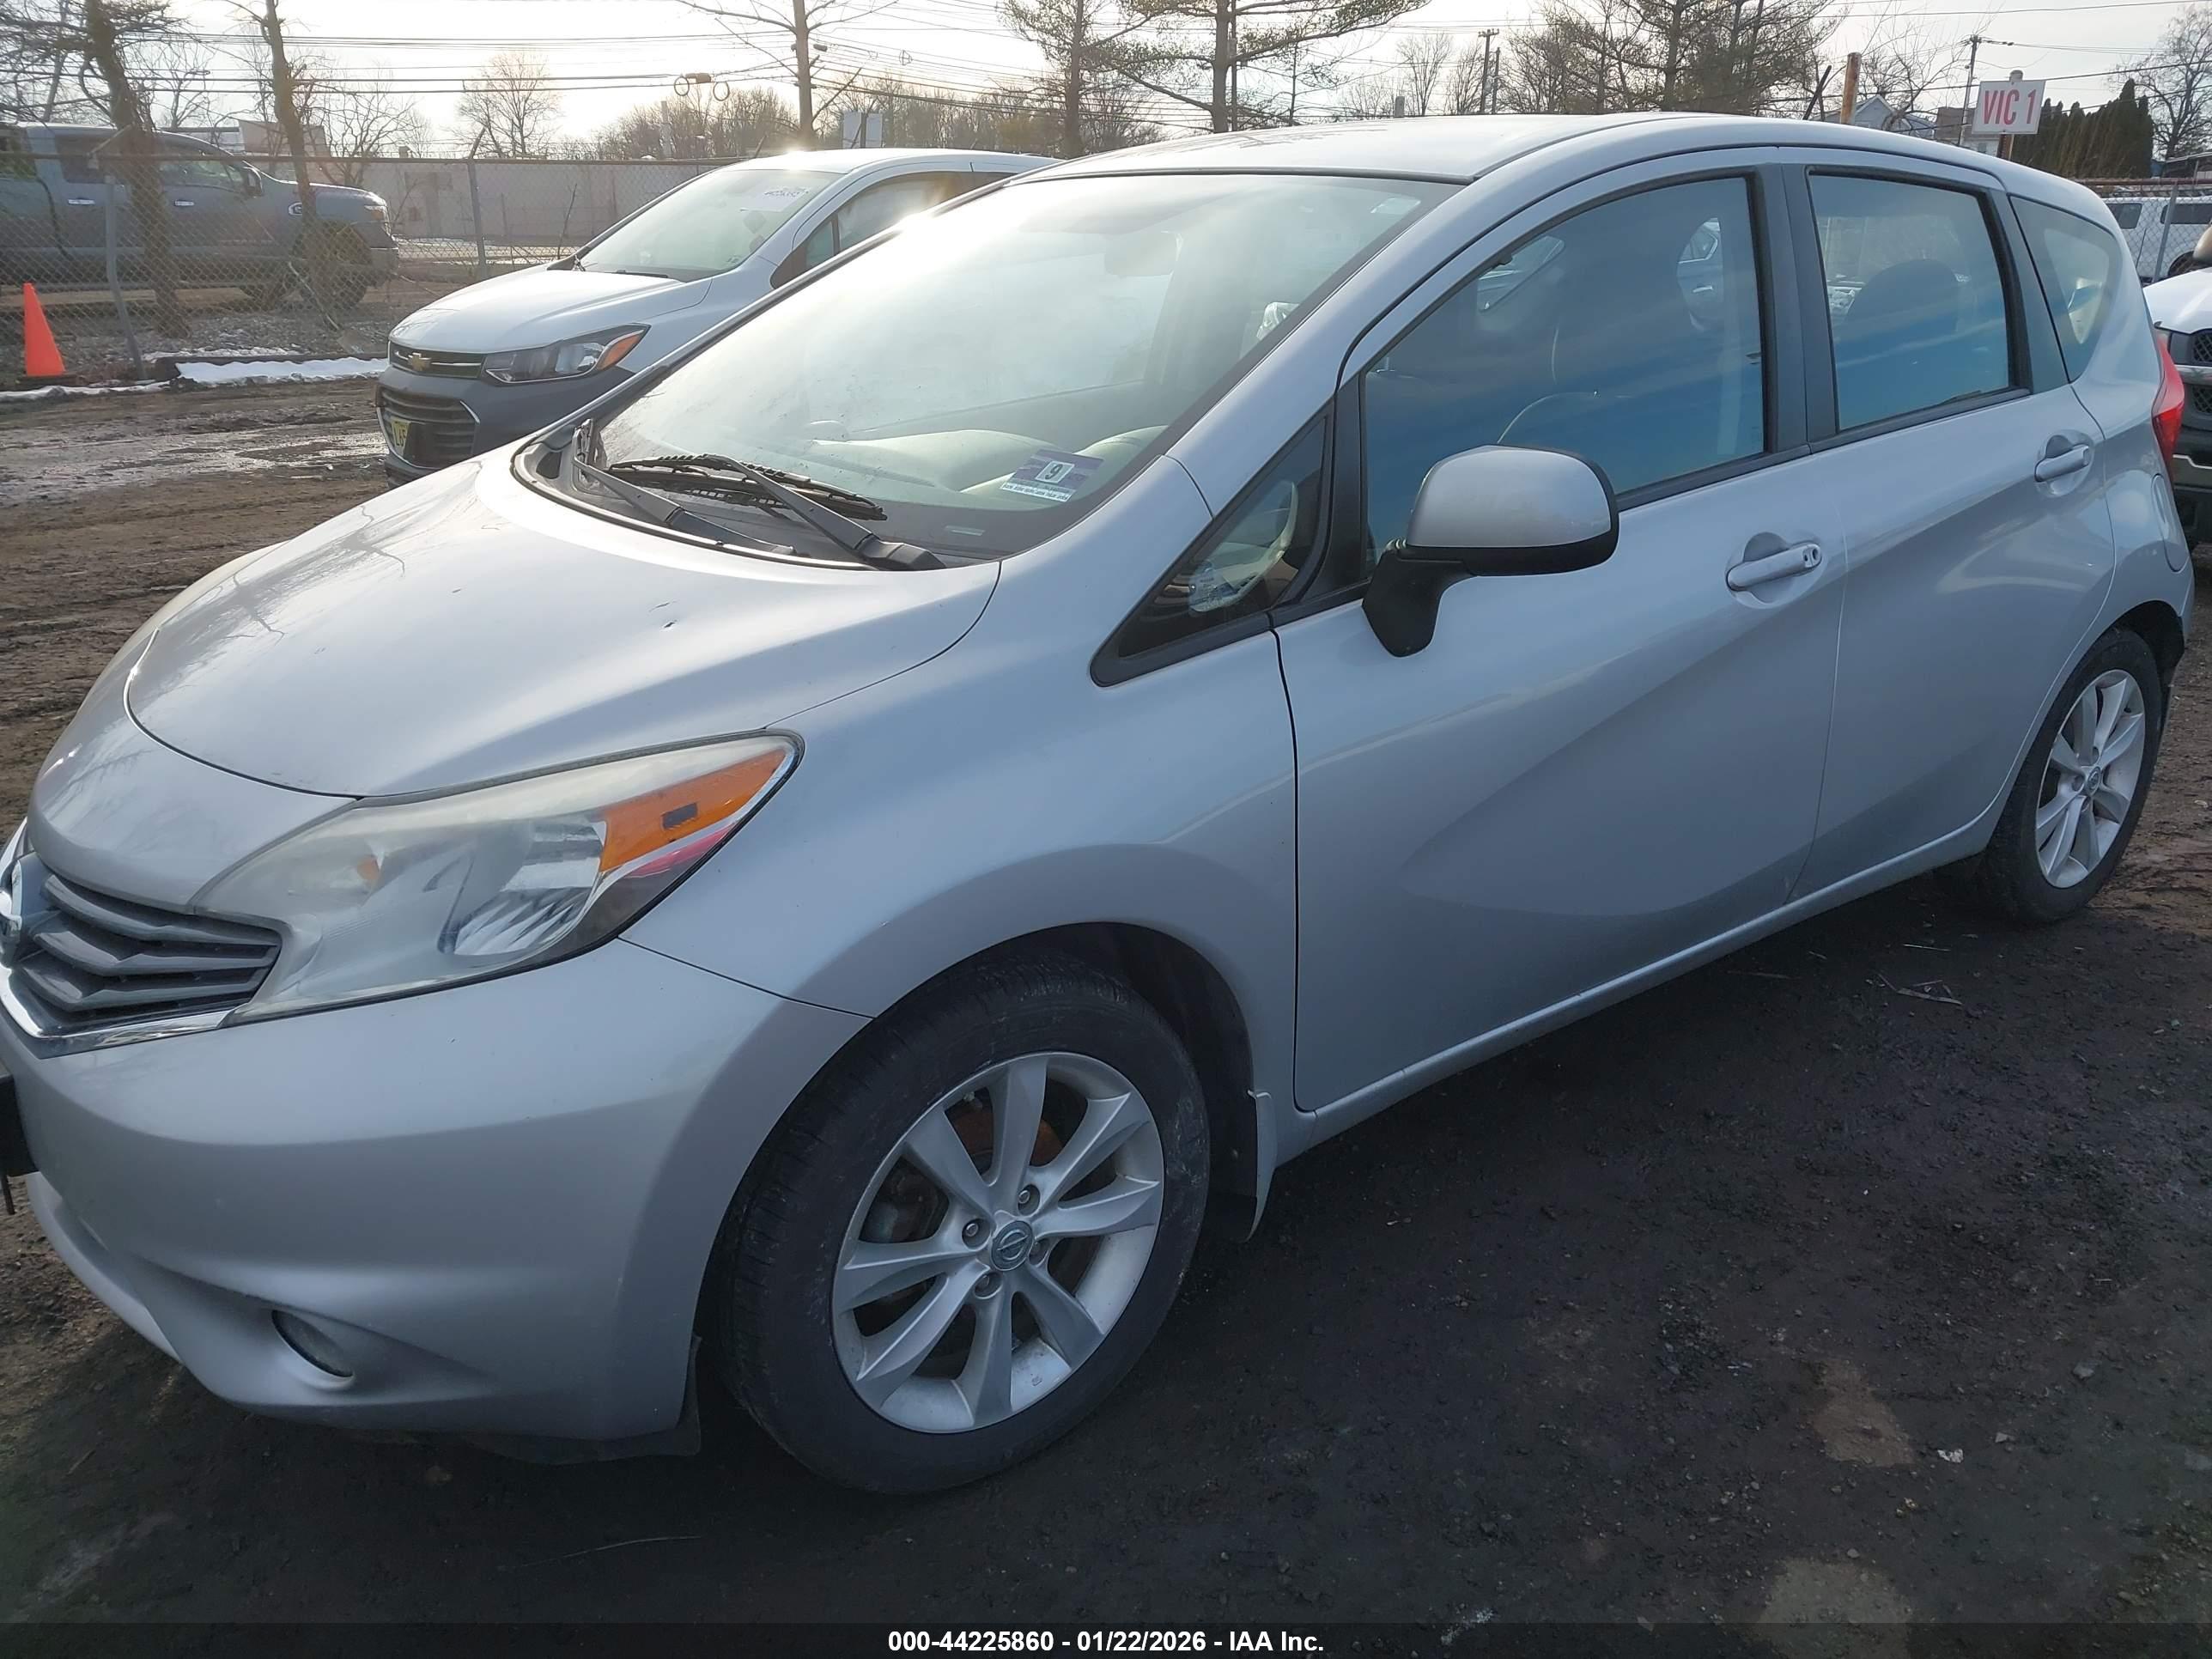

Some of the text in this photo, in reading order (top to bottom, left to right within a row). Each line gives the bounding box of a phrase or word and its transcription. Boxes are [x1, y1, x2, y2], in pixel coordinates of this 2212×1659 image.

[1984, 88, 2037, 125] VIC 1
[1044, 464, 1064, 480] 9
